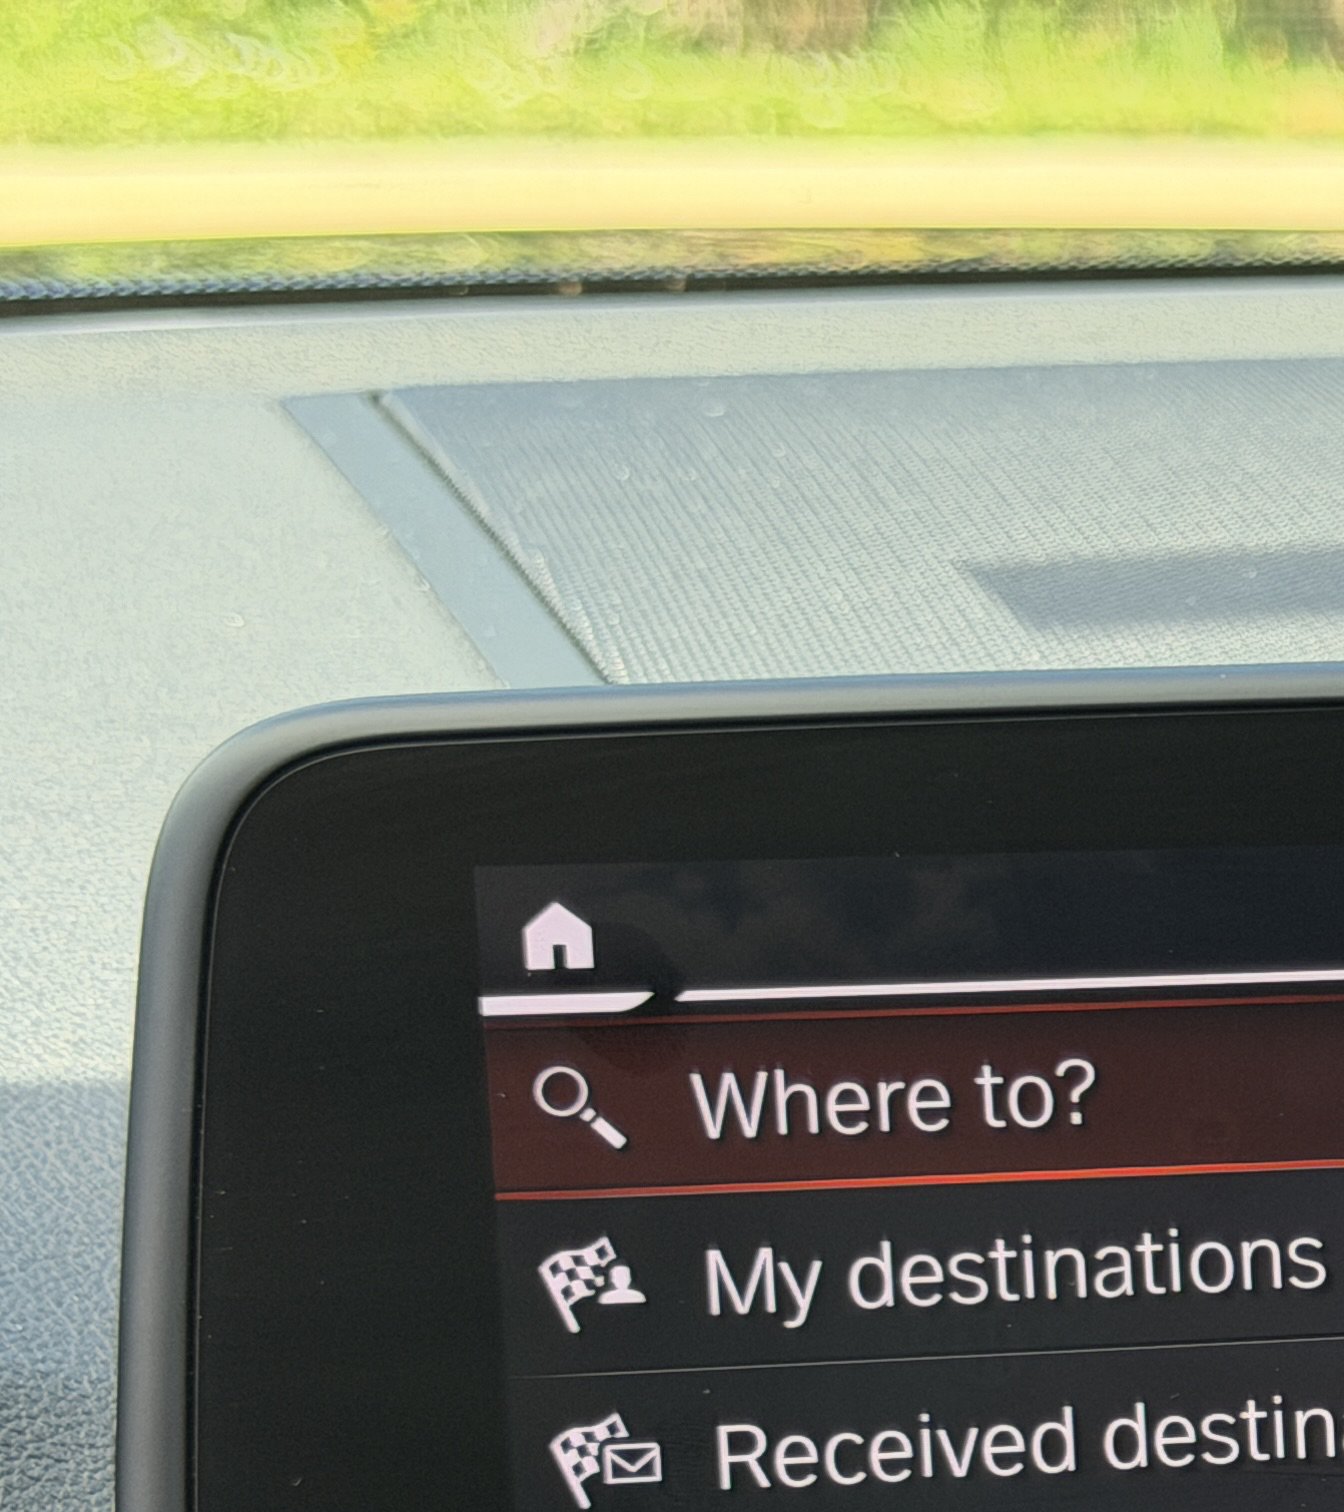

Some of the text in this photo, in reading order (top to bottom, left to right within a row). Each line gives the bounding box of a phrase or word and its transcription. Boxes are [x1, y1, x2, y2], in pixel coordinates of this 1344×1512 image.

[690, 1058, 1095, 1139] Where to?
[706, 1228, 1326, 1328] My destinations
[717, 1406, 1075, 1490] Received
